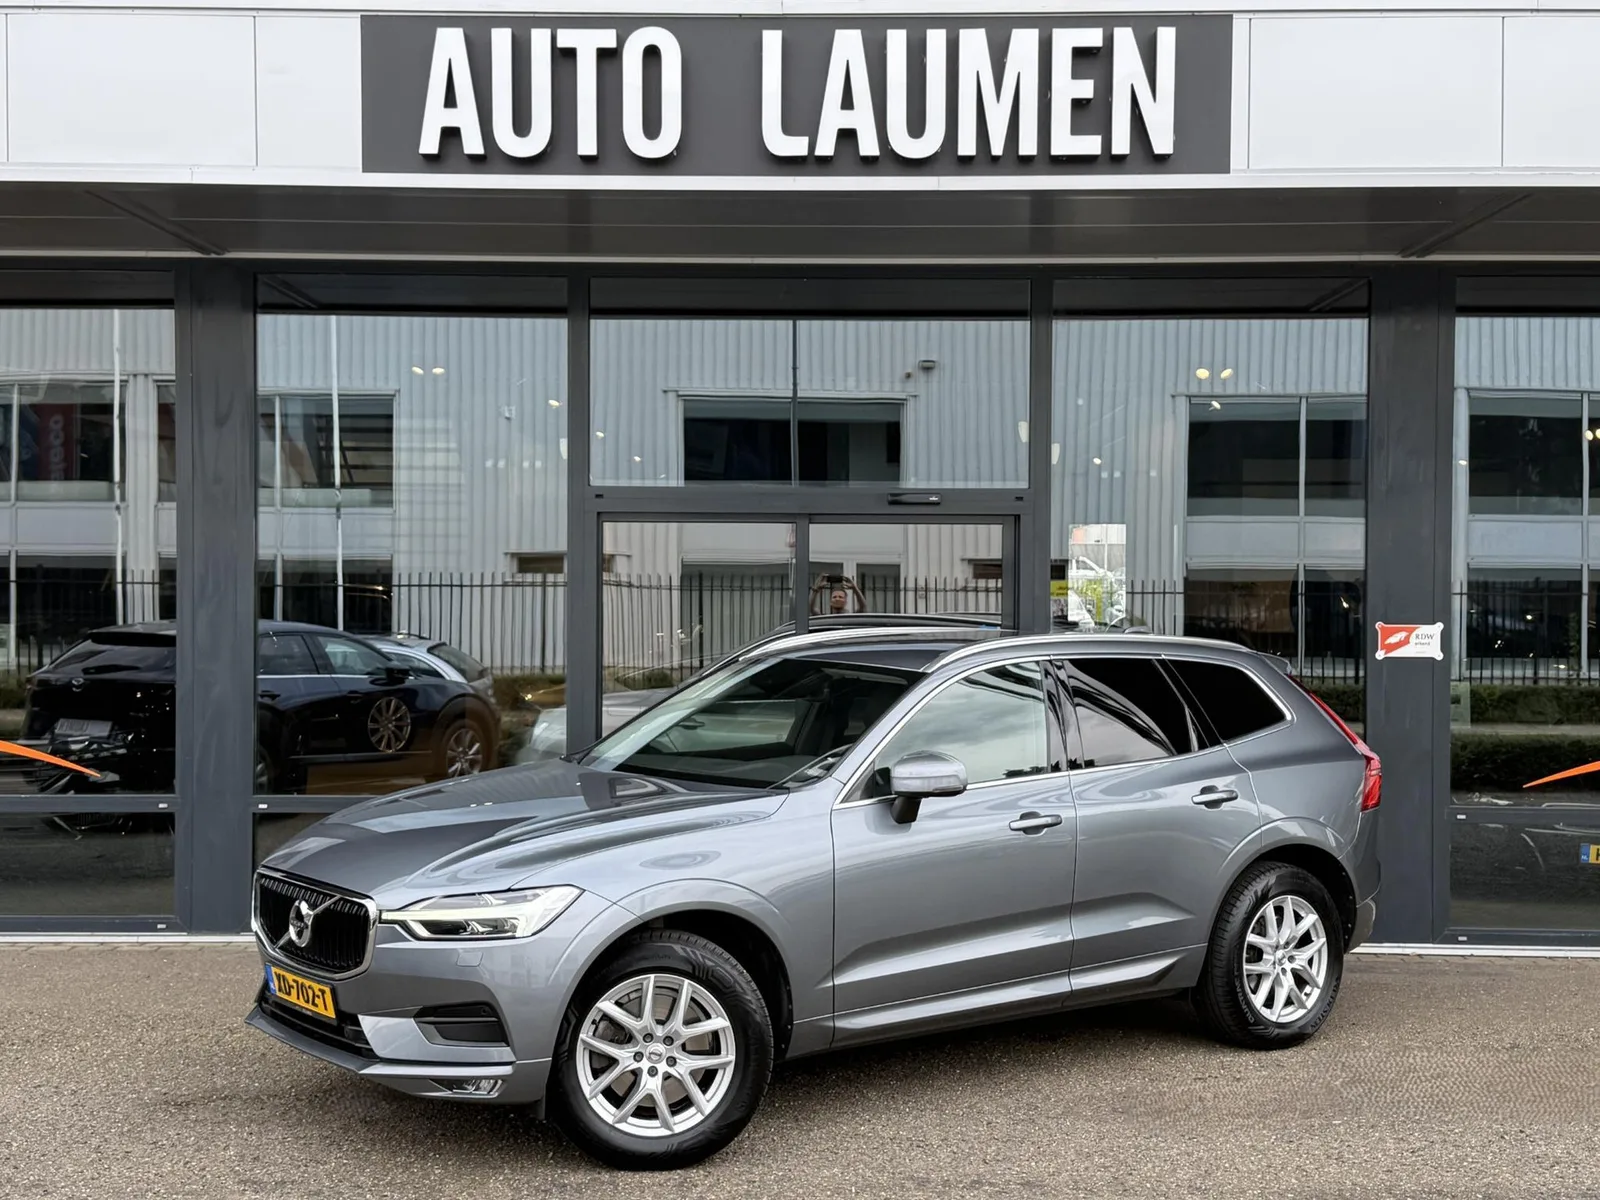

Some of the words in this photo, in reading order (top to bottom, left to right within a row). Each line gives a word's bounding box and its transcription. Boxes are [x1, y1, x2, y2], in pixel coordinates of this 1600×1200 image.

[418, 26, 683, 159] AUTO
[761, 27, 1177, 159] LAUMEN
[273, 970, 329, 1012] XD-702-T
